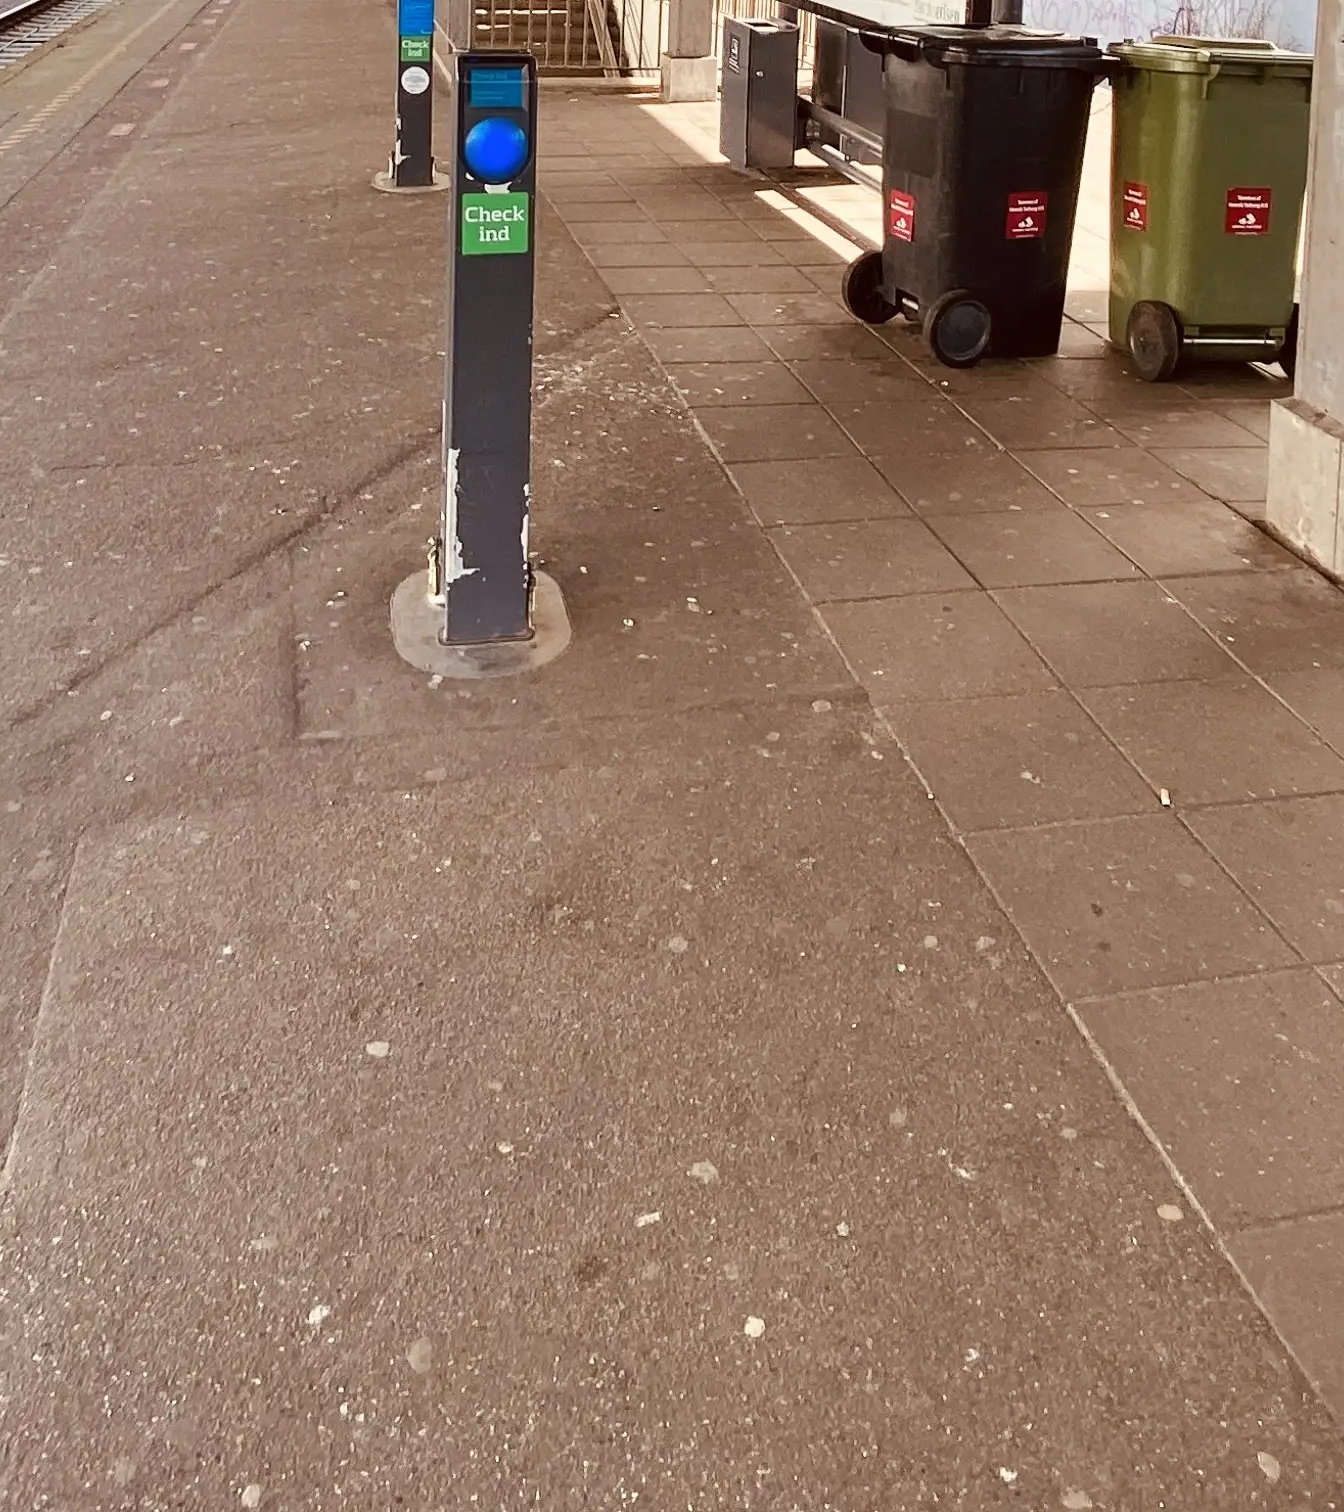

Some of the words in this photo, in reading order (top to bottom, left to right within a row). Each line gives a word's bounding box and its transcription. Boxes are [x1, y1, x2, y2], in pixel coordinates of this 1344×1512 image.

[401, 39, 429, 49] Check
[464, 205, 525, 223] Check
[479, 226, 510, 242] ind
